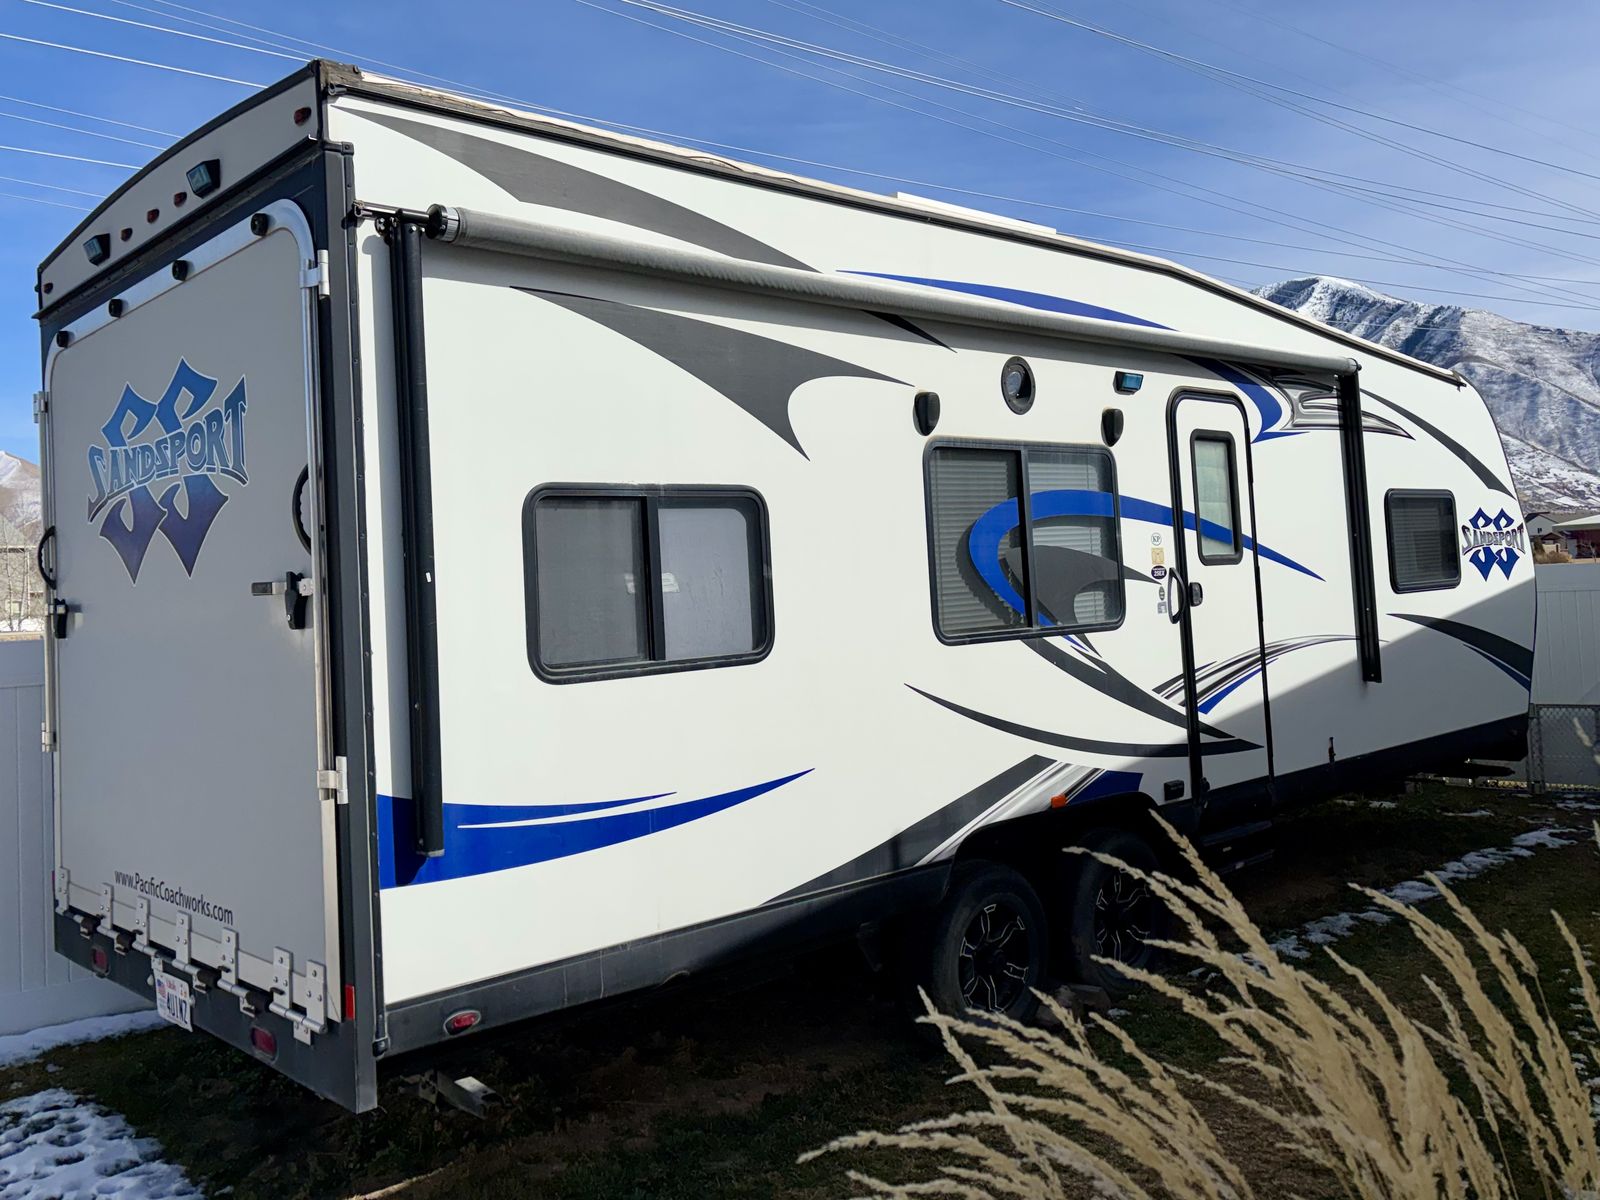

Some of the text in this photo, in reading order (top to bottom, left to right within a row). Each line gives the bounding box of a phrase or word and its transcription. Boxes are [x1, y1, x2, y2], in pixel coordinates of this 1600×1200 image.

[88, 374, 249, 524] SANDSPORT
[1461, 522, 1526, 556] SANDSPORT
[114, 870, 233, 926] www.PacificCoachworks.com
